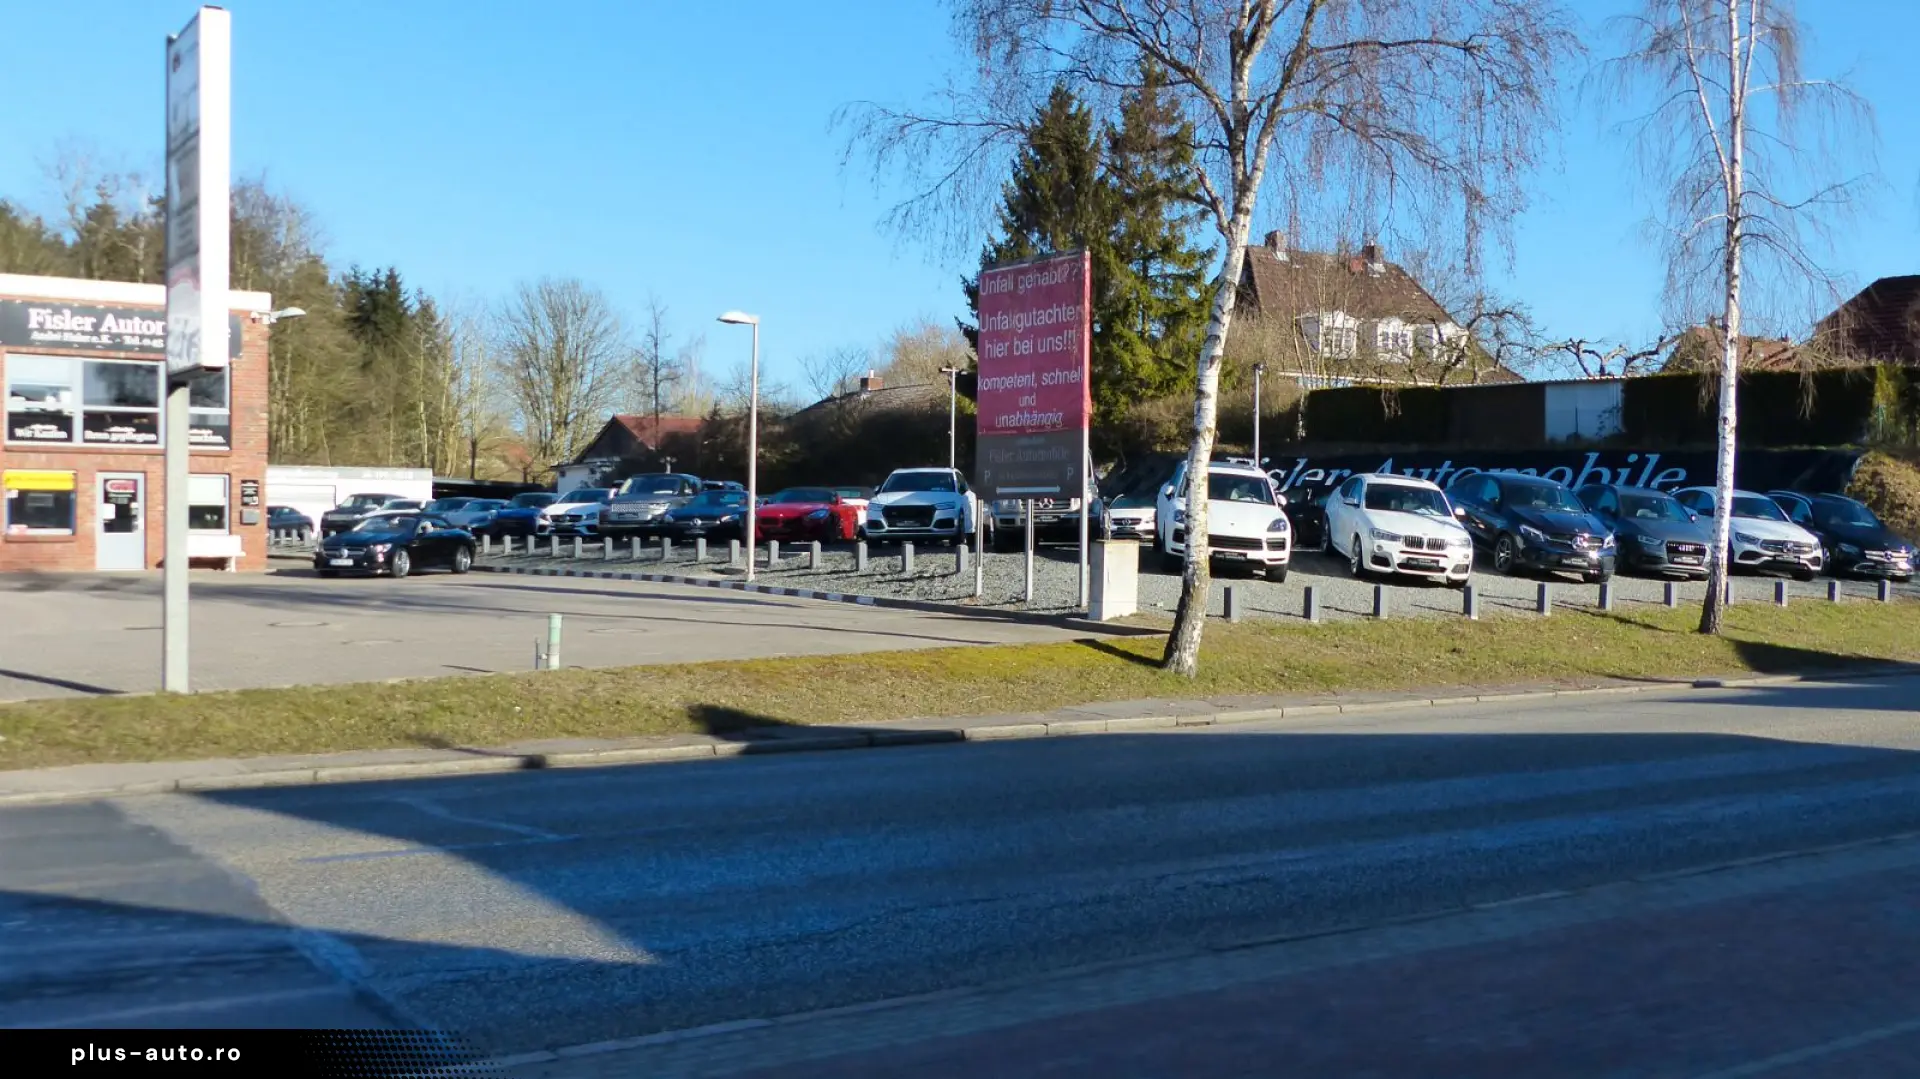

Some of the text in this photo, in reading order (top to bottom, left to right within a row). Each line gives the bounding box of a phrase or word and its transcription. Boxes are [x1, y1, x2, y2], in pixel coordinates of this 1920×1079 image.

[980, 273, 1014, 296] Unfall
[28, 307, 97, 332] Fisler
[985, 339, 1010, 359] hier
[1013, 334, 1033, 356] bei
[978, 366, 1084, 393] kompetent, schnell
[1019, 392, 1037, 407] und
[995, 408, 1064, 429] unabhängig
[1226, 452, 1688, 493] sler Atoobile
